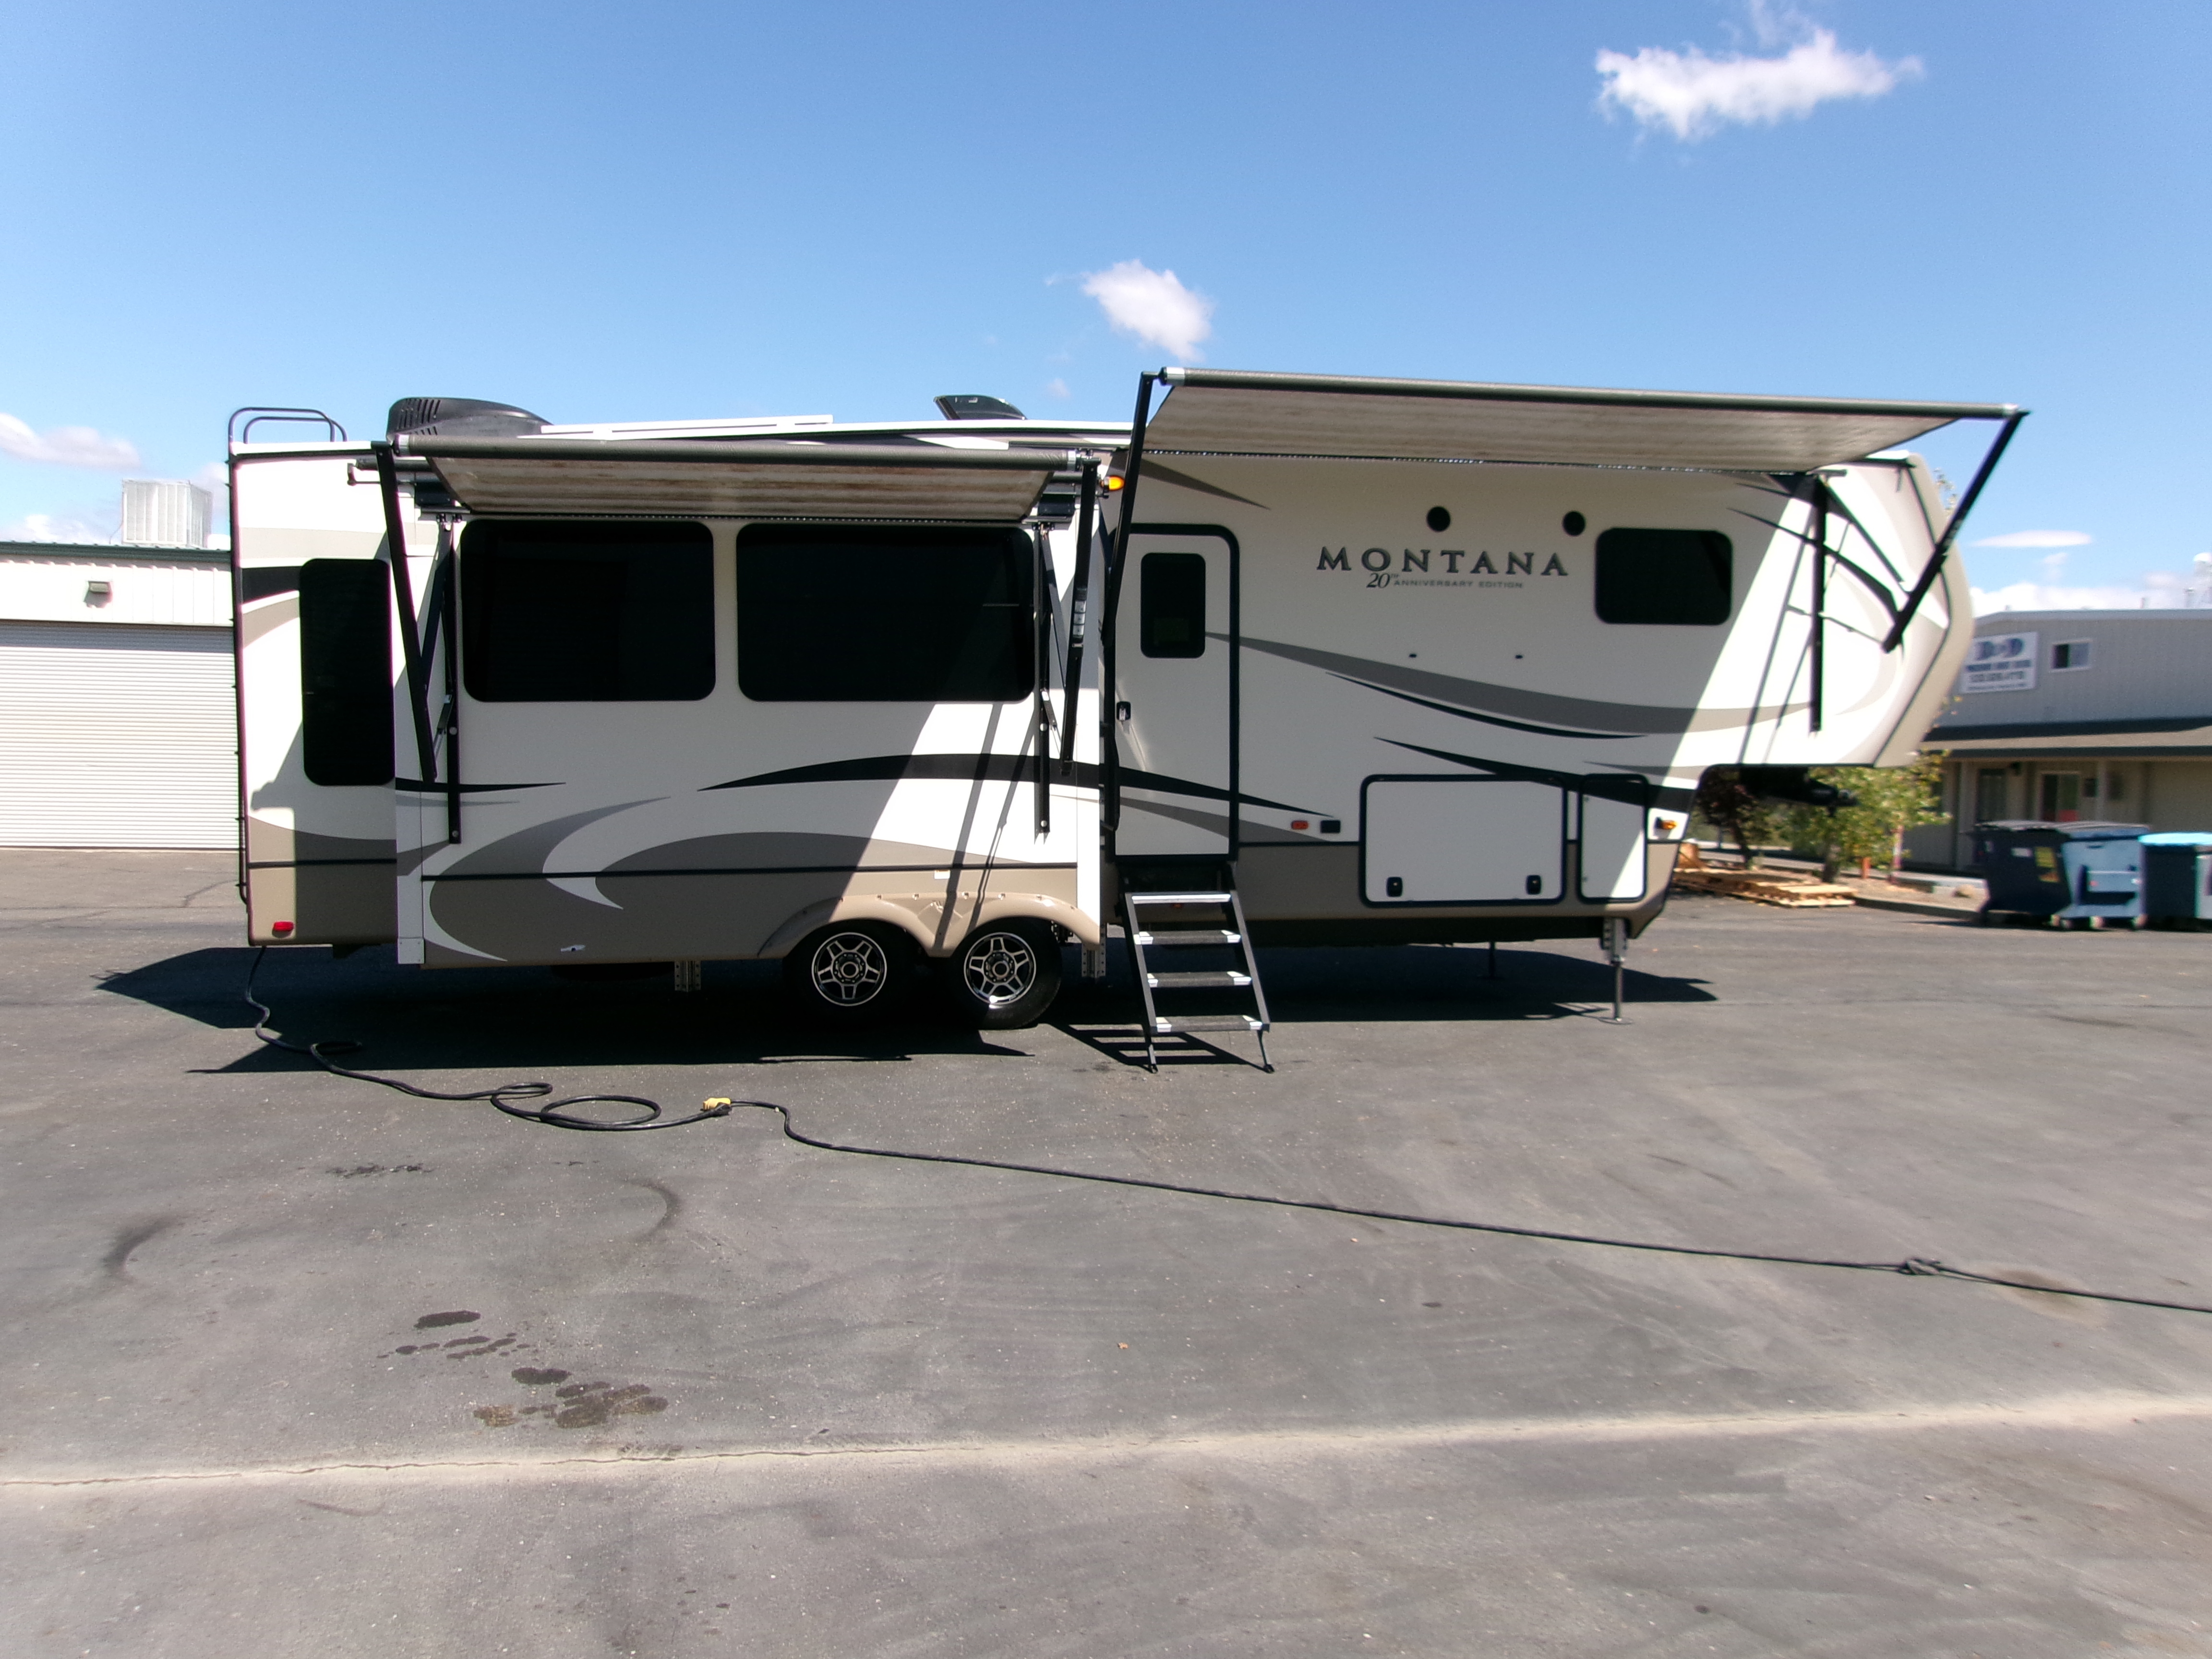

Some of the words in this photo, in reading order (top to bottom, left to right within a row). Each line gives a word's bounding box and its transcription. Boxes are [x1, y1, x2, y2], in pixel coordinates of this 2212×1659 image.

[1316, 546, 1568, 576] MONTANA
[1394, 579, 1473, 588] ANNIVERSARY
[1479, 580, 1523, 589] EDITION
